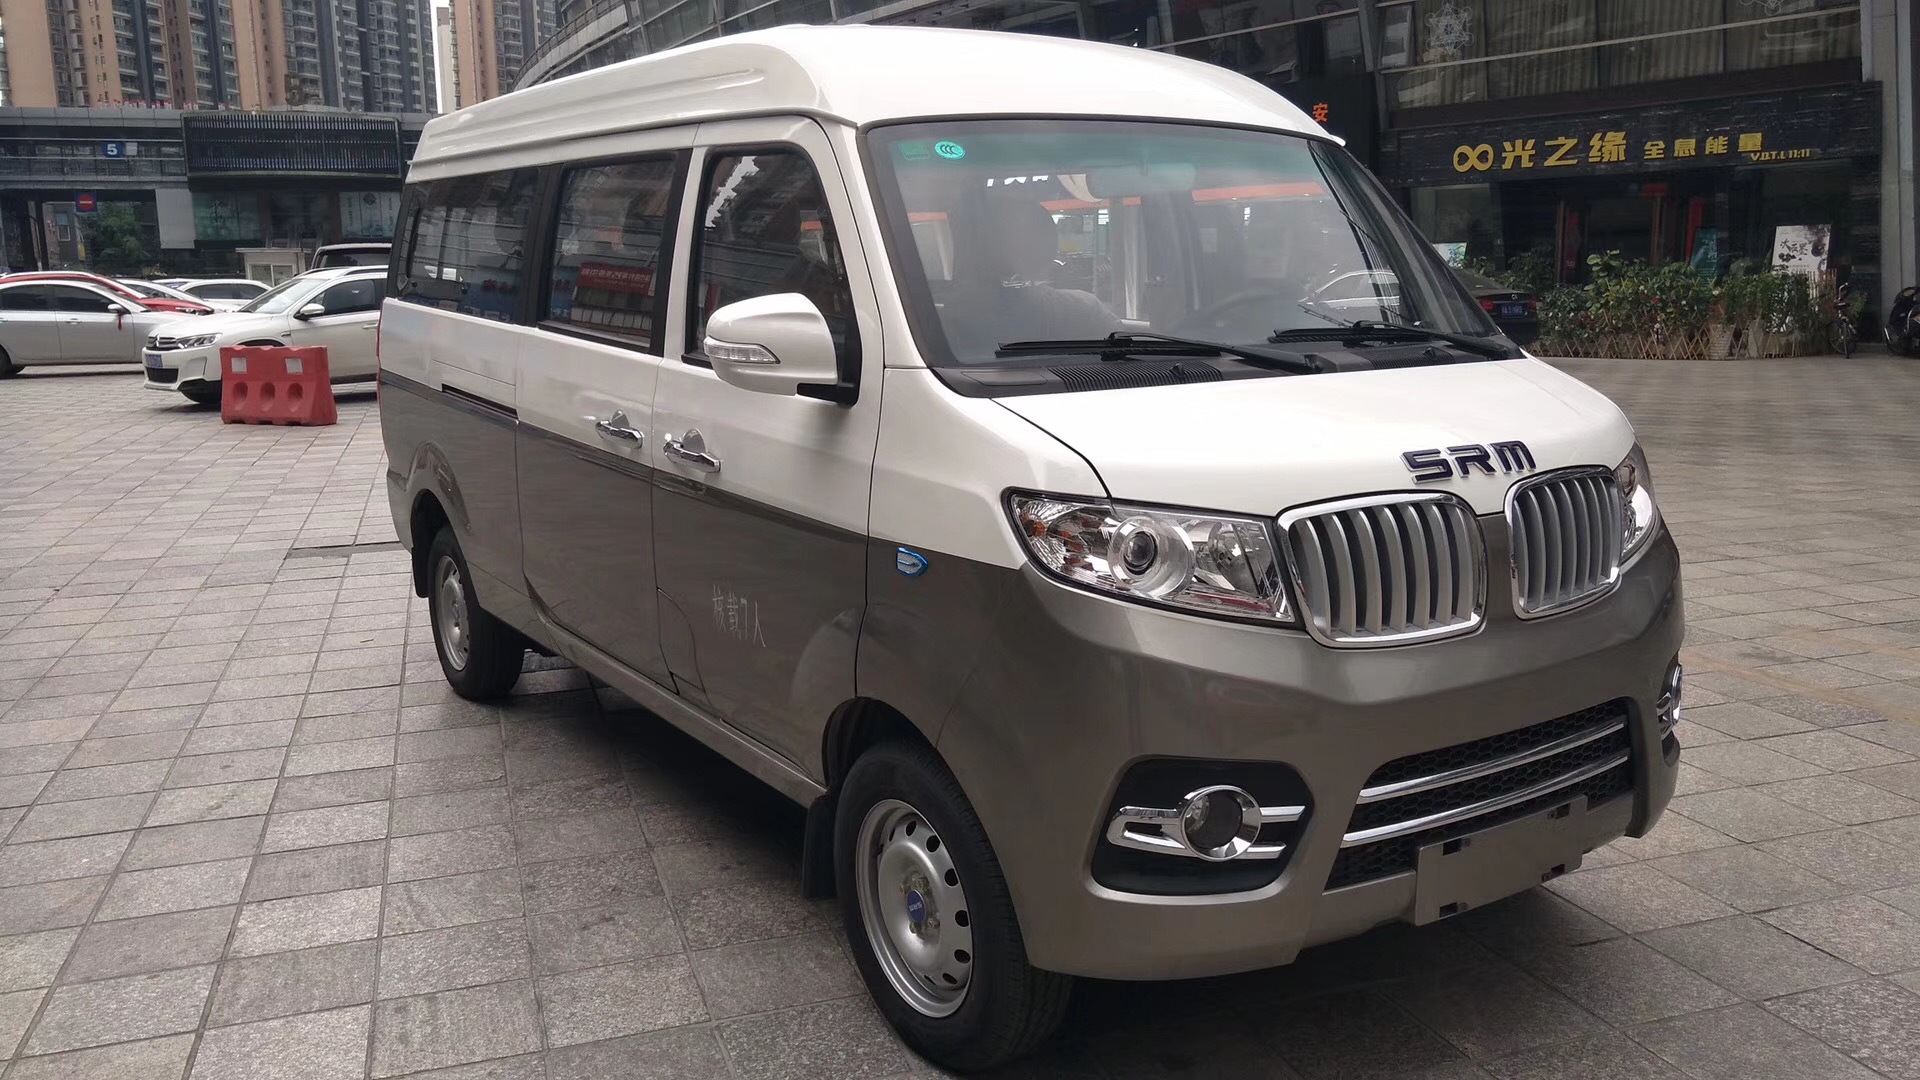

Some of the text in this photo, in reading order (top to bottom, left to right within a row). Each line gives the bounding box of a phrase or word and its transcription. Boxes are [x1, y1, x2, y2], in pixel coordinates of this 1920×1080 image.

[1312, 103, 1328, 121] 安
[107, 143, 118, 155] 5
[1501, 131, 1763, 170] 光之缘 全息能量
[1400, 440, 1537, 485] SRM
